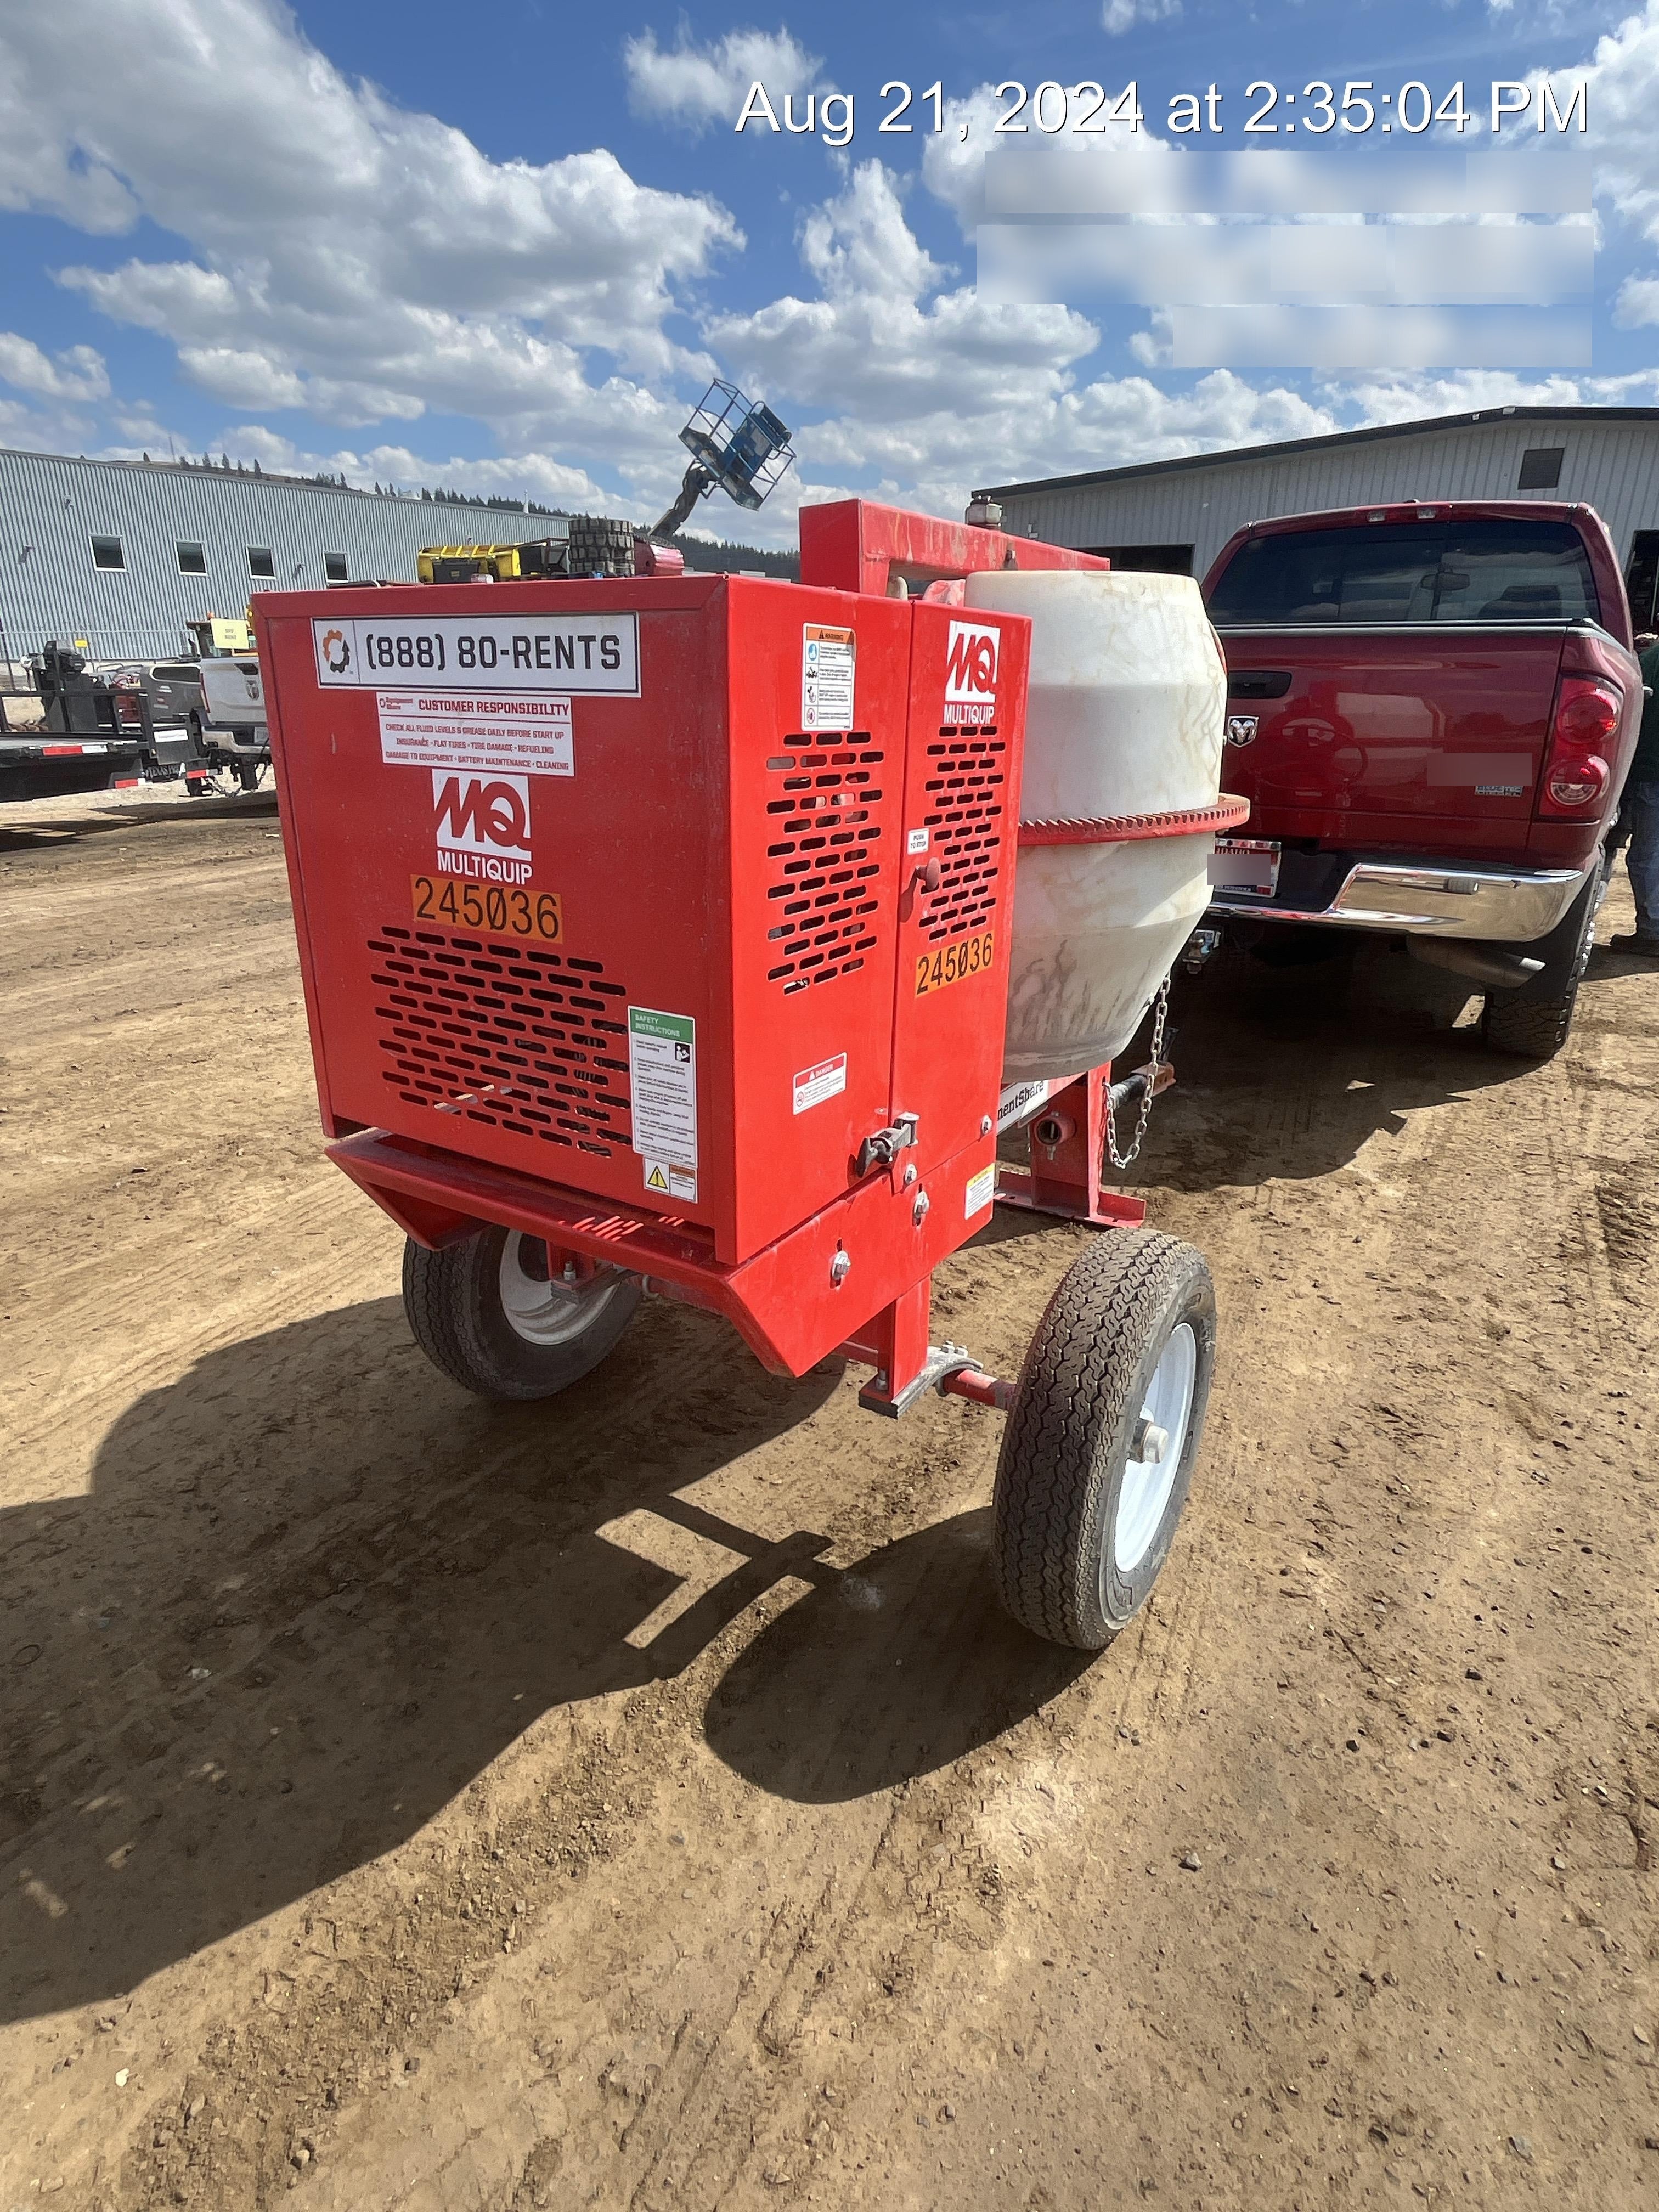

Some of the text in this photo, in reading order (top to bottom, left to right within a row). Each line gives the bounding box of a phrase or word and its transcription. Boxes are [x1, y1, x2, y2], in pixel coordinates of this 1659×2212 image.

[366, 634, 621, 671] (888) 80-RENTS
[419, 699, 474, 712] CUSTOMER
[477, 701, 569, 716] RESPONSIBILITY
[943, 703, 995, 725] MULTIQUIP
[435, 726, 456, 734] LEVELS
[533, 730, 553, 739] START
[555, 731, 564, 740] UP
[518, 744, 554, 754] REFUELING
[437, 850, 533, 885] MULTIQUIP
[415, 877, 558, 939] 245036
[917, 933, 992, 995] 245036
[635, 1014, 659, 1024] SAFETY
[635, 1023, 680, 1037] INSTRUCTIONS
